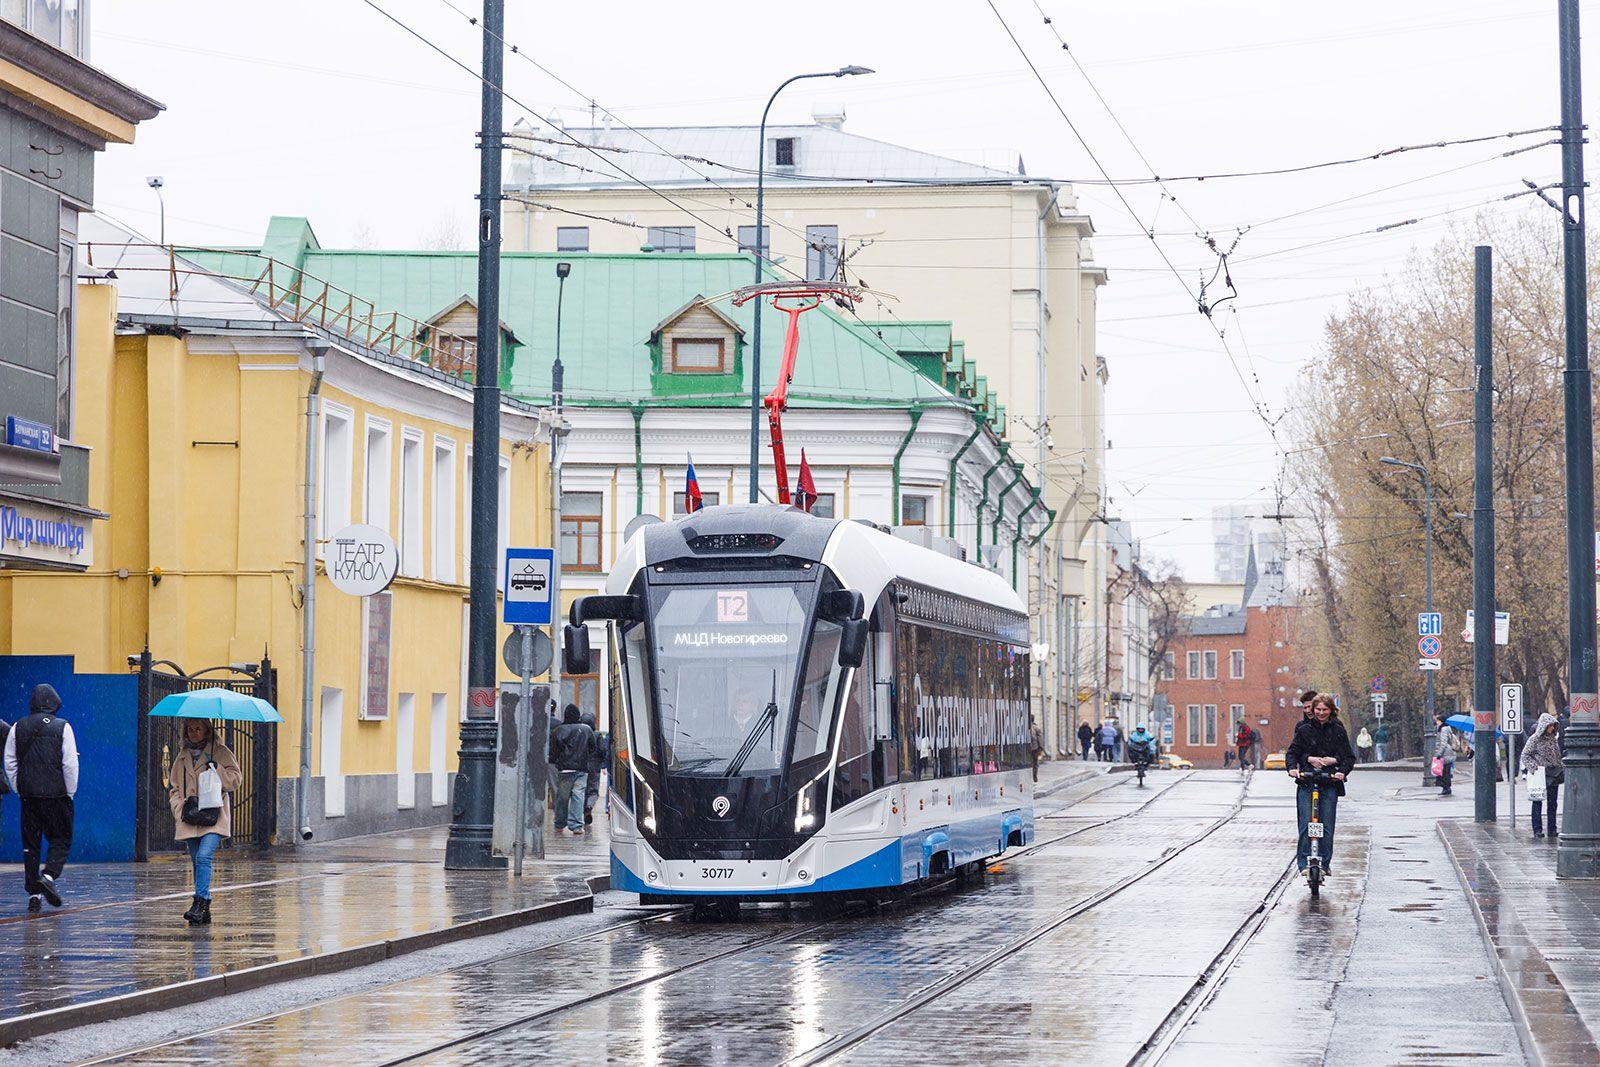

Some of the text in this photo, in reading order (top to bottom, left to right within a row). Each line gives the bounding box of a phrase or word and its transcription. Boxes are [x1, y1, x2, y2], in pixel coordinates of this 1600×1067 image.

[41, 430, 50, 445] 32
[1, 504, 84, 555] Мир шитья
[335, 543, 386, 562] ТЕАТР
[334, 560, 387, 580] КУКОЛ
[718, 596, 747, 616] Т2
[674, 632, 788, 647] МЦД Новогиреево
[1507, 688, 1517, 730] СТОП
[701, 868, 734, 879] 30717
